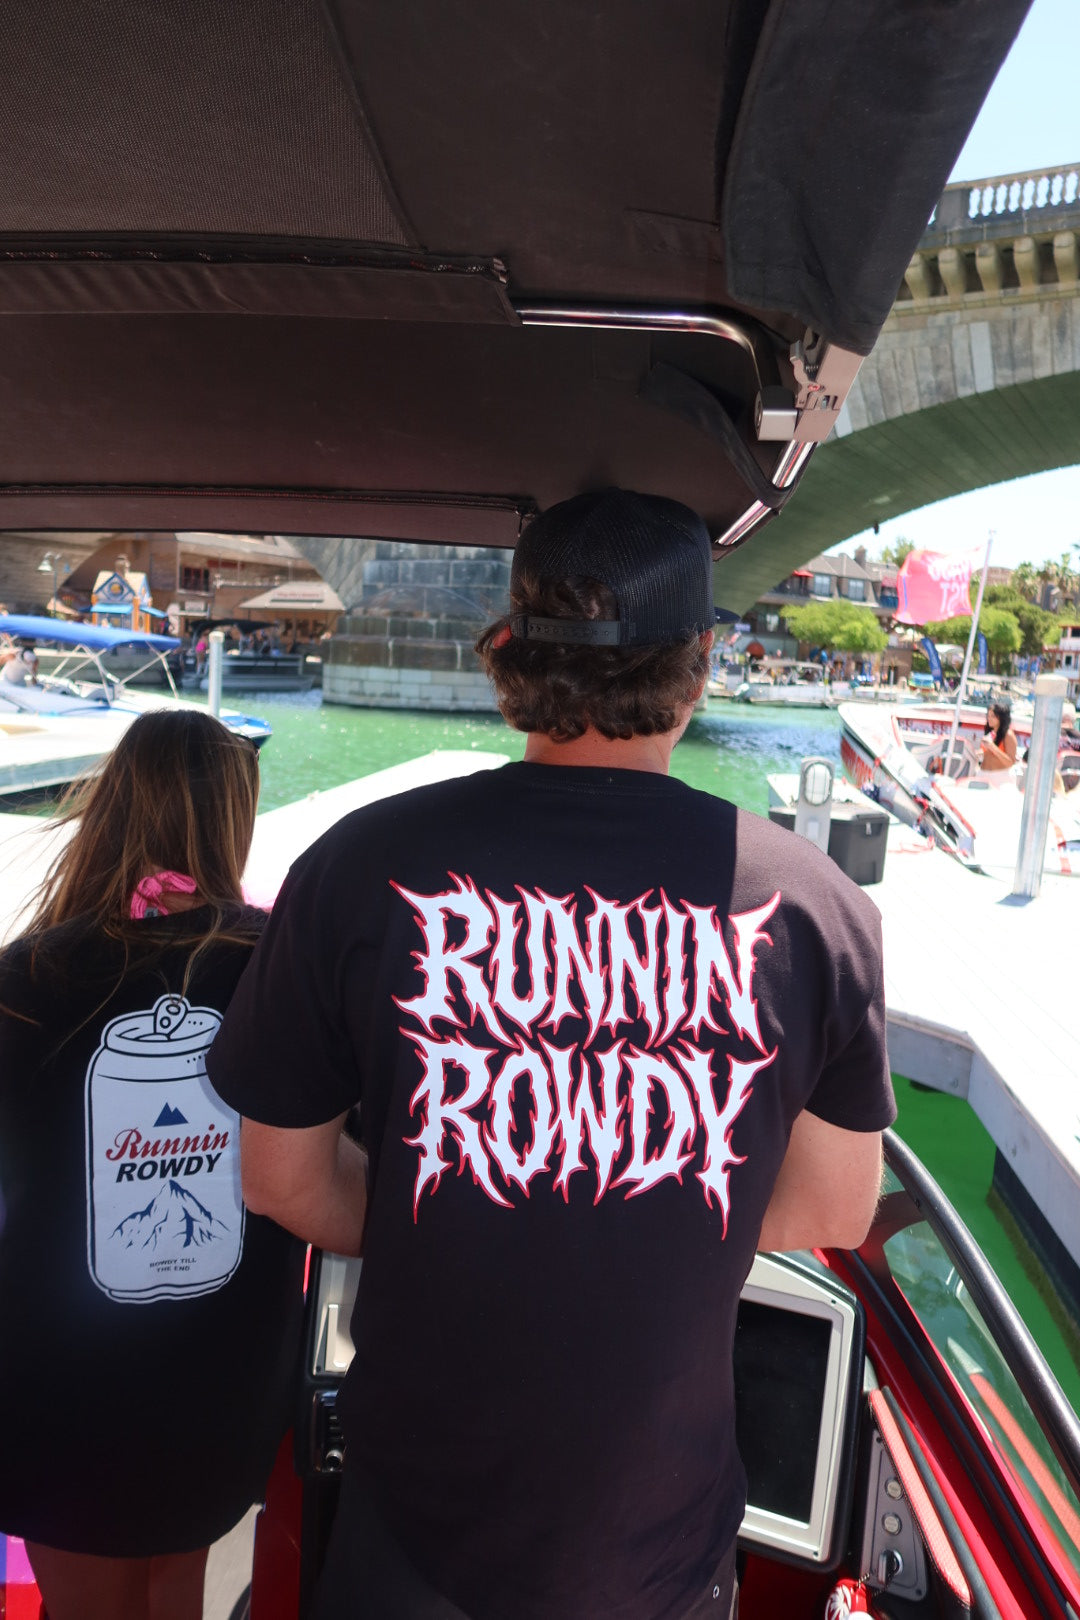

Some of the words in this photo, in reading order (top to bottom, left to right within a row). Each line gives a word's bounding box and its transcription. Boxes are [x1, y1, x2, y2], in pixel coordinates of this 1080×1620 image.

[389, 871, 782, 1056] RUNNIN
[105, 1123, 231, 1161] Runnin
[399, 1026, 779, 1240] ROWDY
[115, 1152, 223, 1183] ROWDY
[149, 1258, 178, 1268] ROWDY
[157, 1265, 171, 1273] THE
